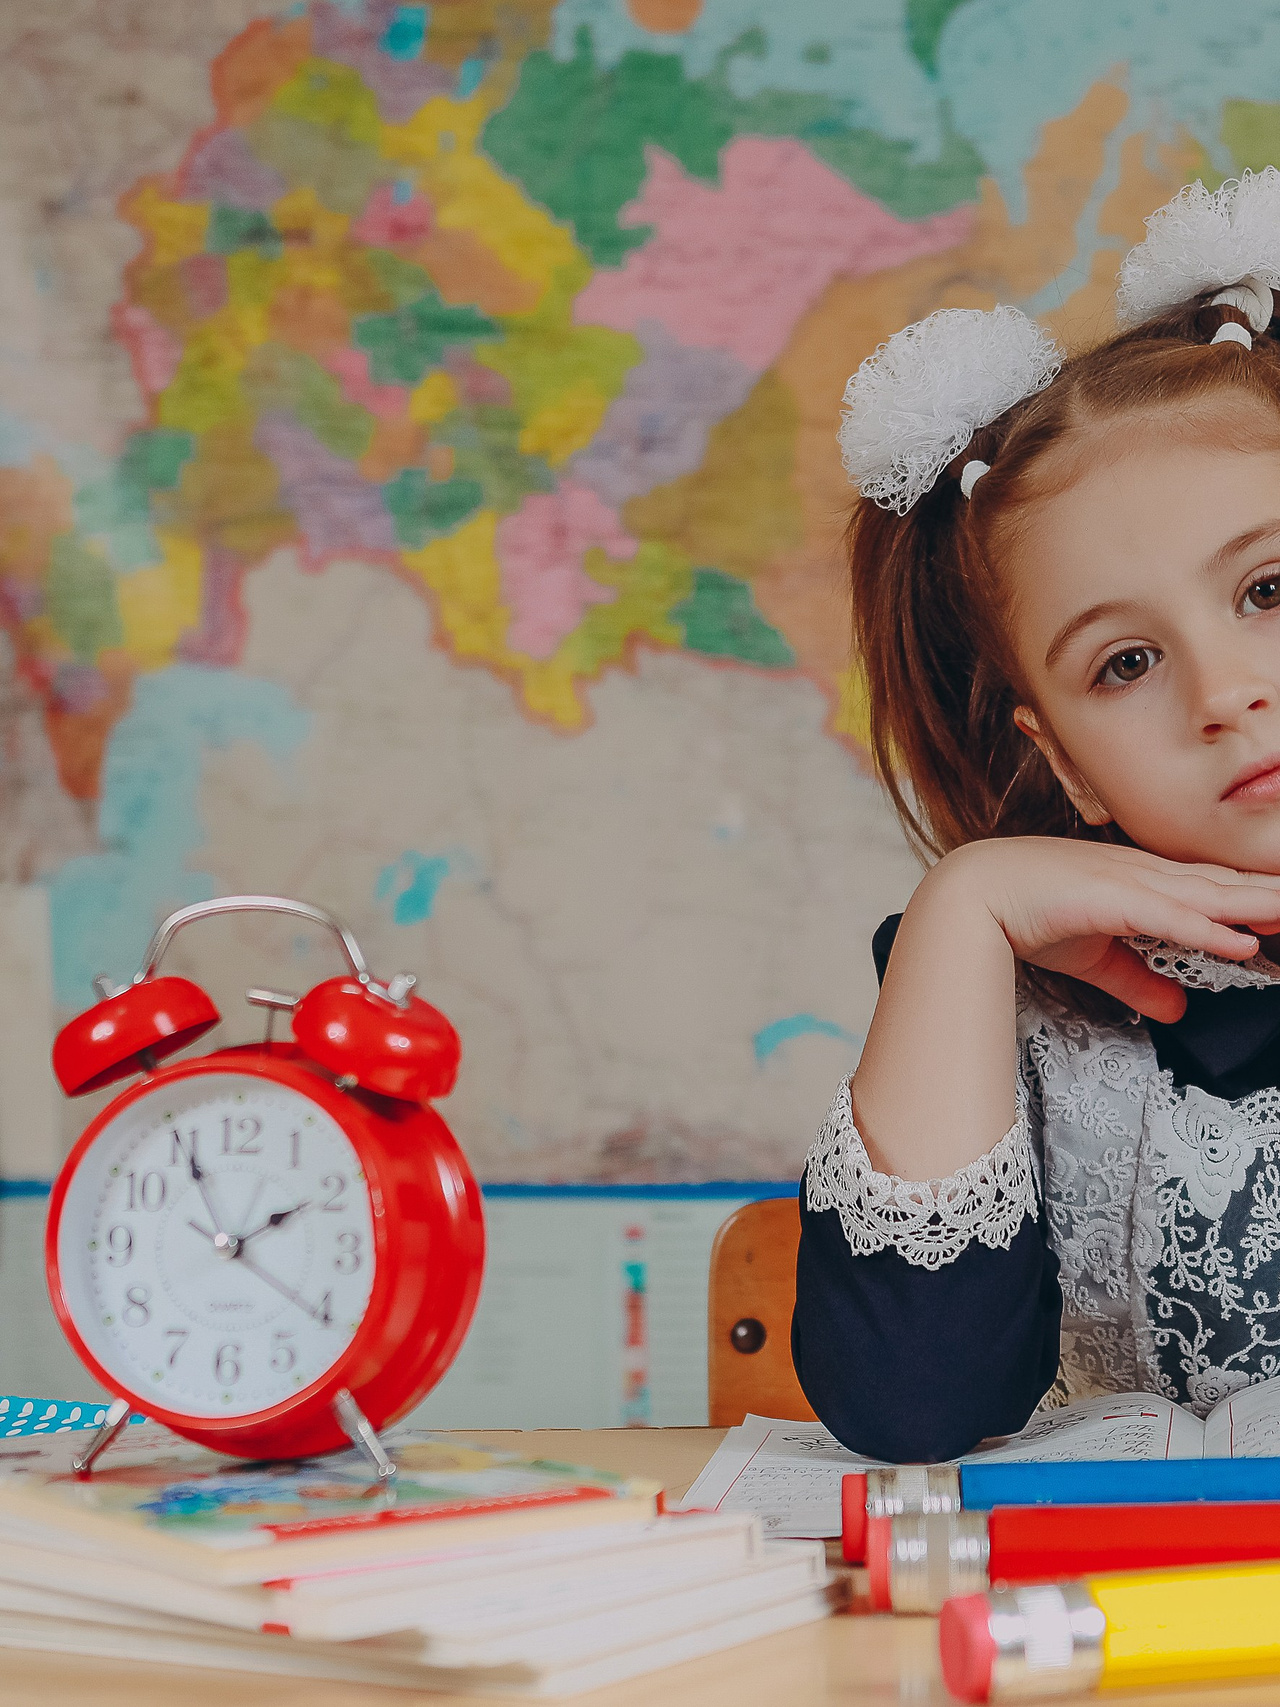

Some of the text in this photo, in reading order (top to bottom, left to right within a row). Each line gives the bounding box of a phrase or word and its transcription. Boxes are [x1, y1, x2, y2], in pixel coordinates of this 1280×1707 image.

[167, 1128, 199, 1167] 11
[218, 1116, 261, 1156] 12
[288, 1129, 301, 1170] 1
[123, 1171, 166, 1212] 10
[321, 1174, 347, 1212] 2
[107, 1225, 133, 1268] 9
[334, 1232, 361, 1275] 3
[122, 1286, 149, 1327] 8
[311, 1290, 334, 1330] 4
[164, 1328, 190, 1369] 7
[214, 1344, 241, 1386] 6
[270, 1331, 296, 1373] 5
